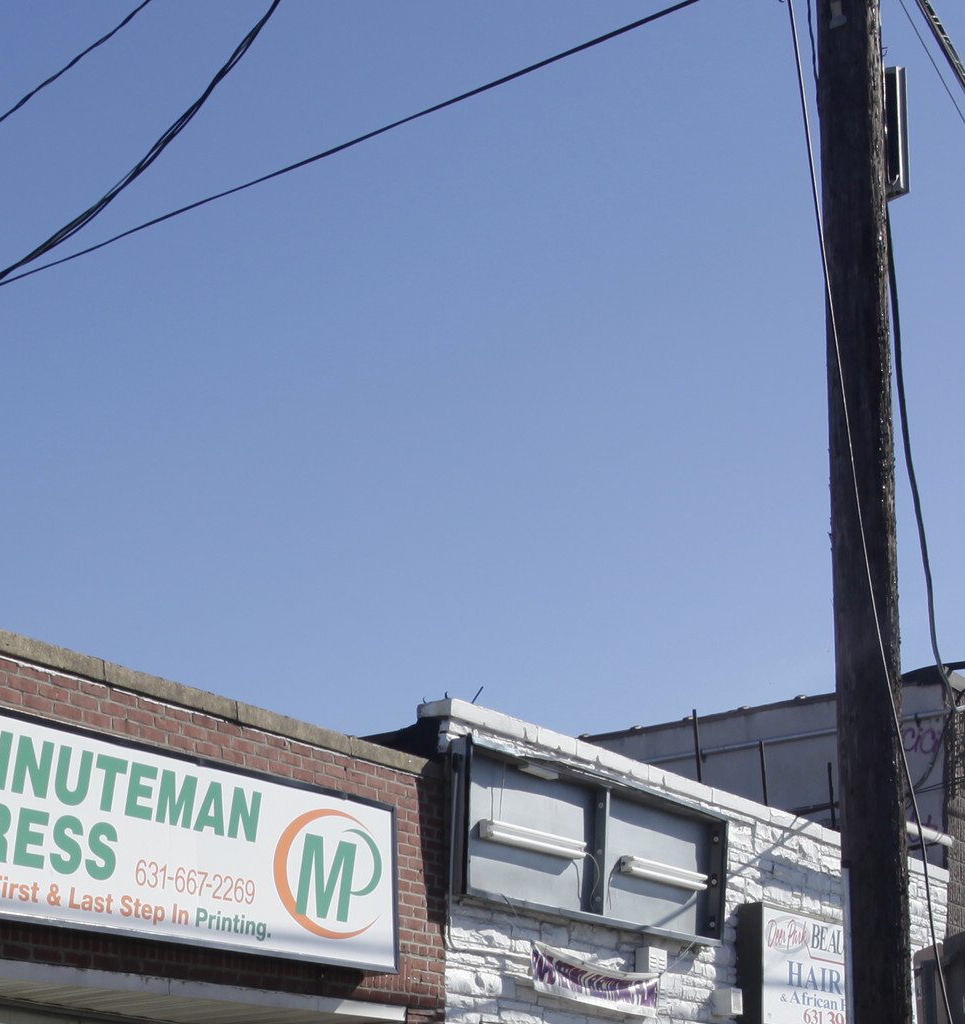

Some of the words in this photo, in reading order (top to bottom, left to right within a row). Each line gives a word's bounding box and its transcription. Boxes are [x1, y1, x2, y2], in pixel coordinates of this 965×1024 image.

[135, 858, 255, 906] 631-667-2269
[46, 884, 62, 908] &
[68, 886, 114, 916] Last
[120, 894, 166, 927] Step
[172, 902, 190, 927] In
[195, 907, 272, 942] Printing.
[787, 919, 807, 951] Park
[787, 960, 842, 995] HAIR
[780, 994, 788, 1002] &
[790, 991, 838, 1011] African
